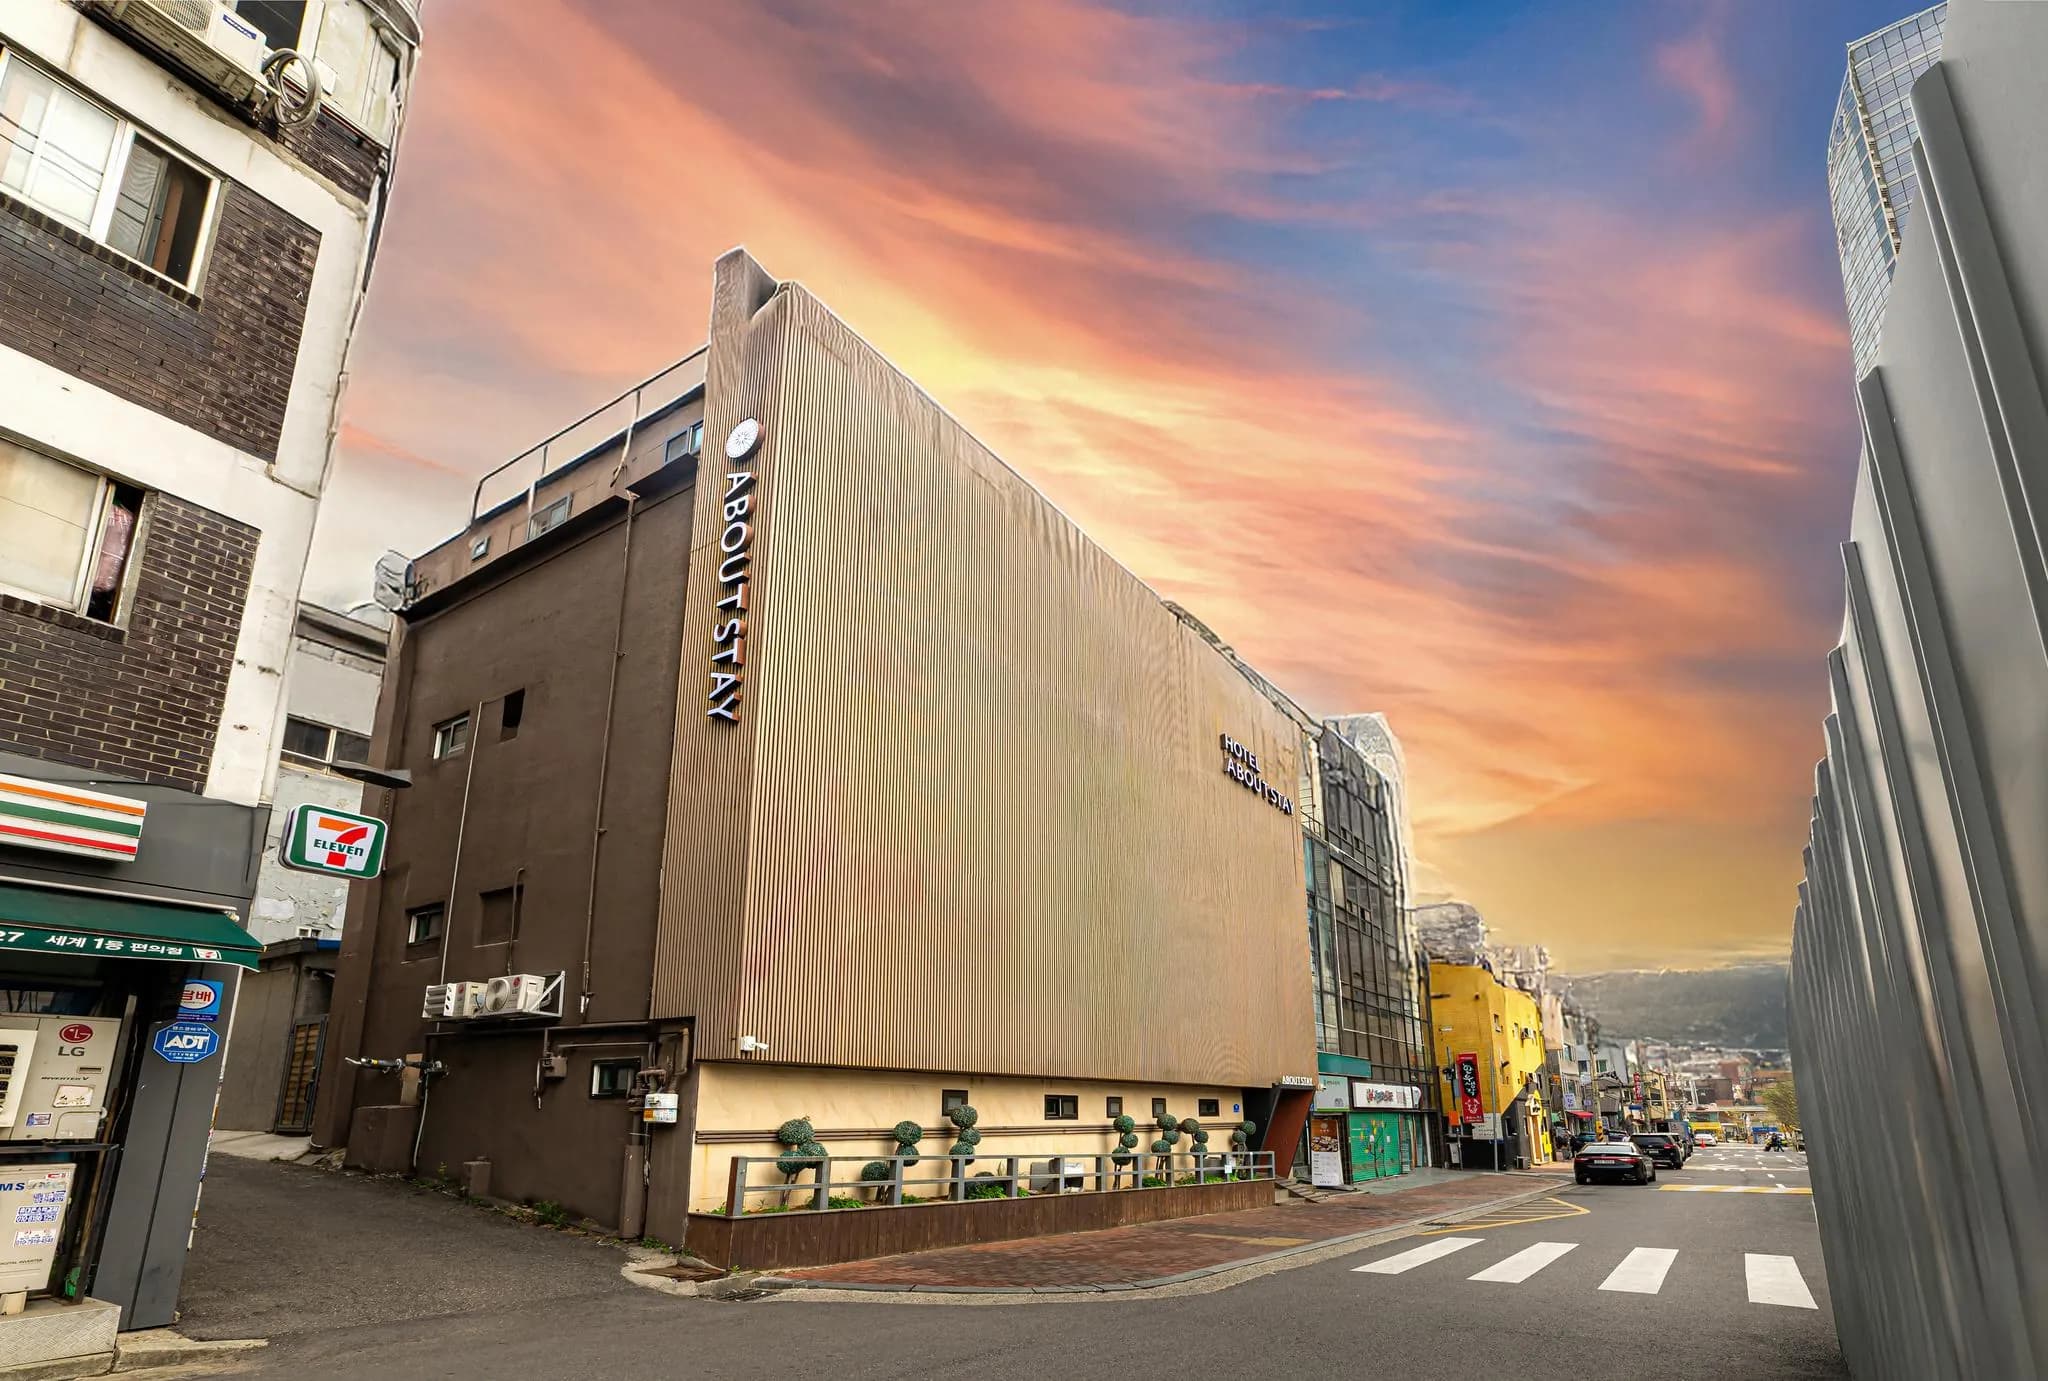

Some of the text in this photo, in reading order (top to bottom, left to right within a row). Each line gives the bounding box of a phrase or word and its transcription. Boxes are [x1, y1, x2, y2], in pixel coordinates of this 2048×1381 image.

[707, 471, 754, 721] ABOUTSTAY
[1223, 734, 1261, 773] HOTEL
[1225, 757, 1295, 814] ABOUTSTAY
[45, 935, 88, 948] 세계
[93, 938, 125, 950] 1등
[129, 942, 183, 955] 편의점
[181, 989, 212, 1002] 담배
[58, 1046, 85, 1057] LG
[165, 1034, 210, 1050] ADT
